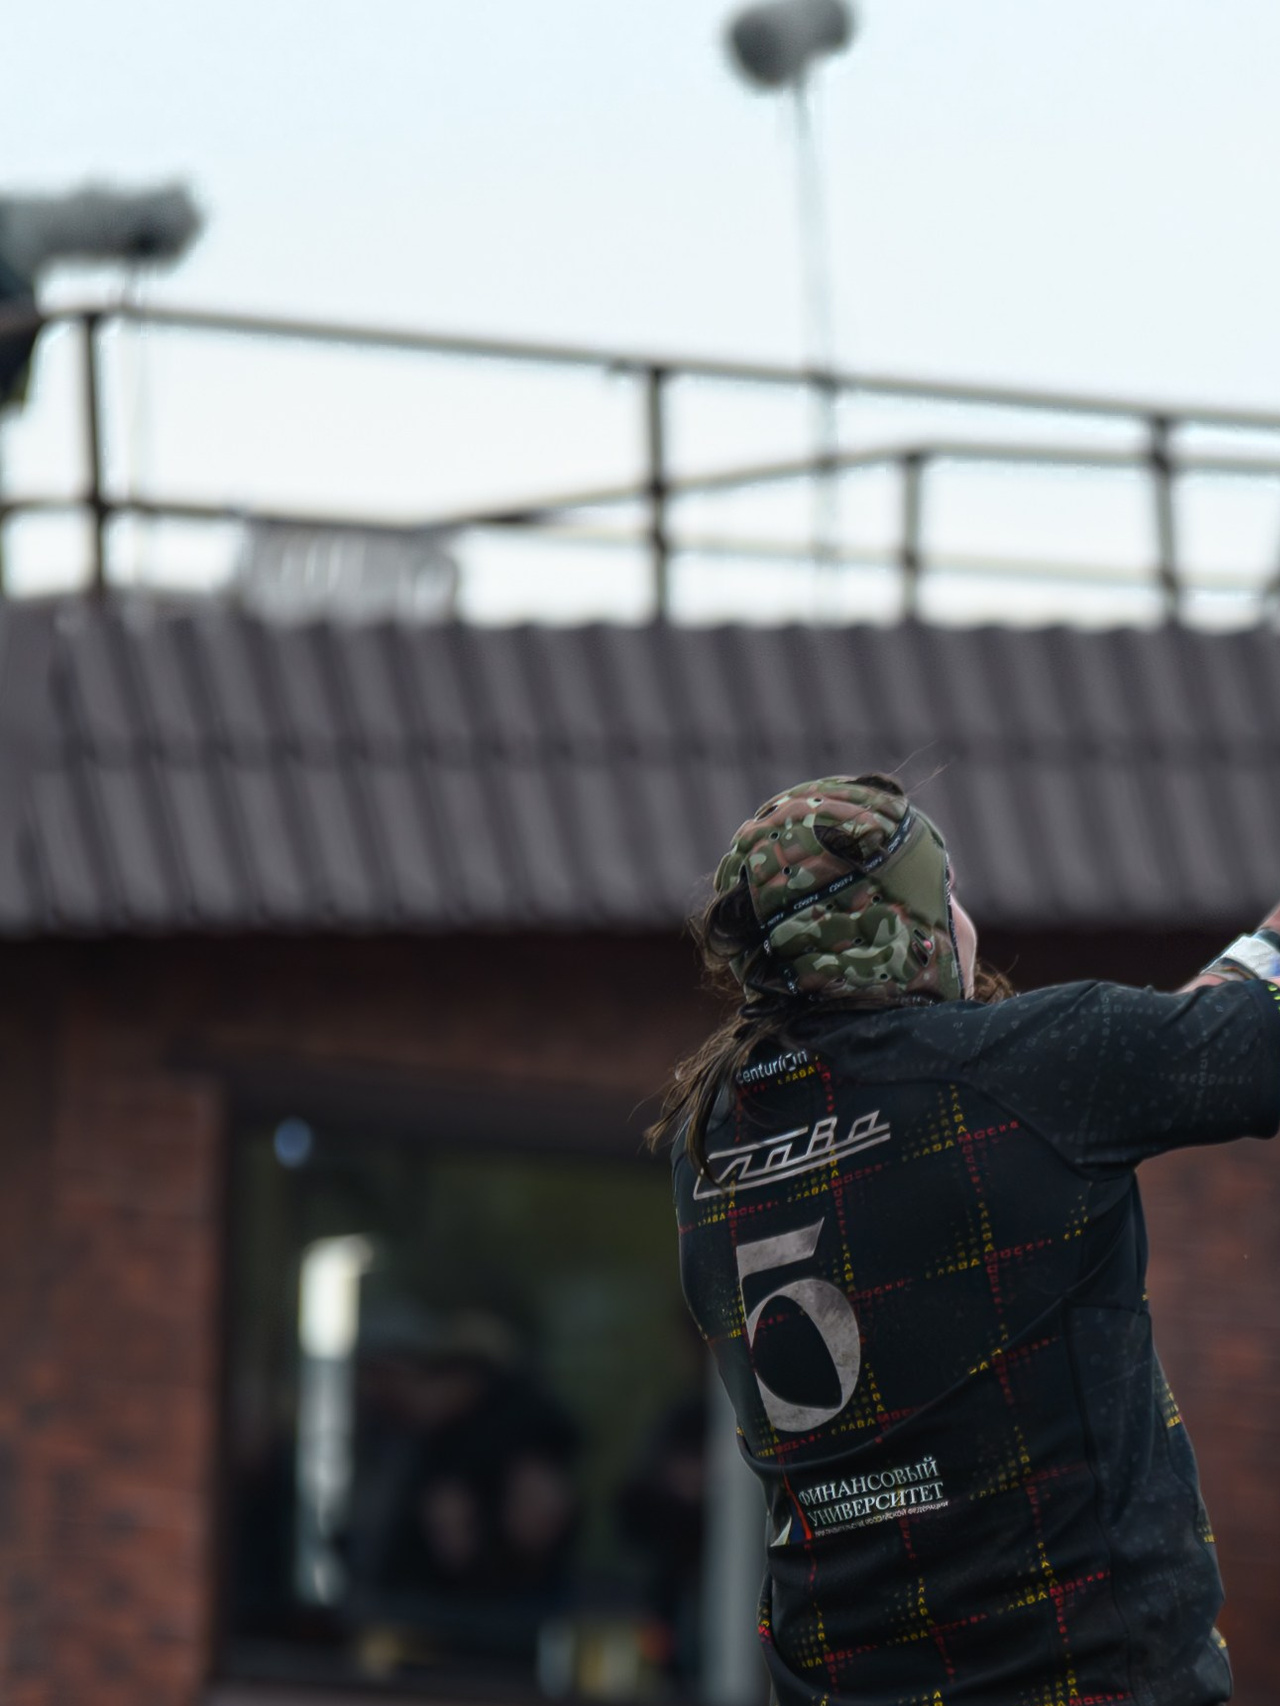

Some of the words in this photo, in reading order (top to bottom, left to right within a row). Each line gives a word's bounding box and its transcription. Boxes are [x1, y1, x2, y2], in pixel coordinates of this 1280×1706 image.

[736, 1217, 861, 1432] 5
[797, 1456, 941, 1507] ФИНАНСОВЫЙ
[807, 1482, 944, 1528] УНИВЕРСИТЕТ
